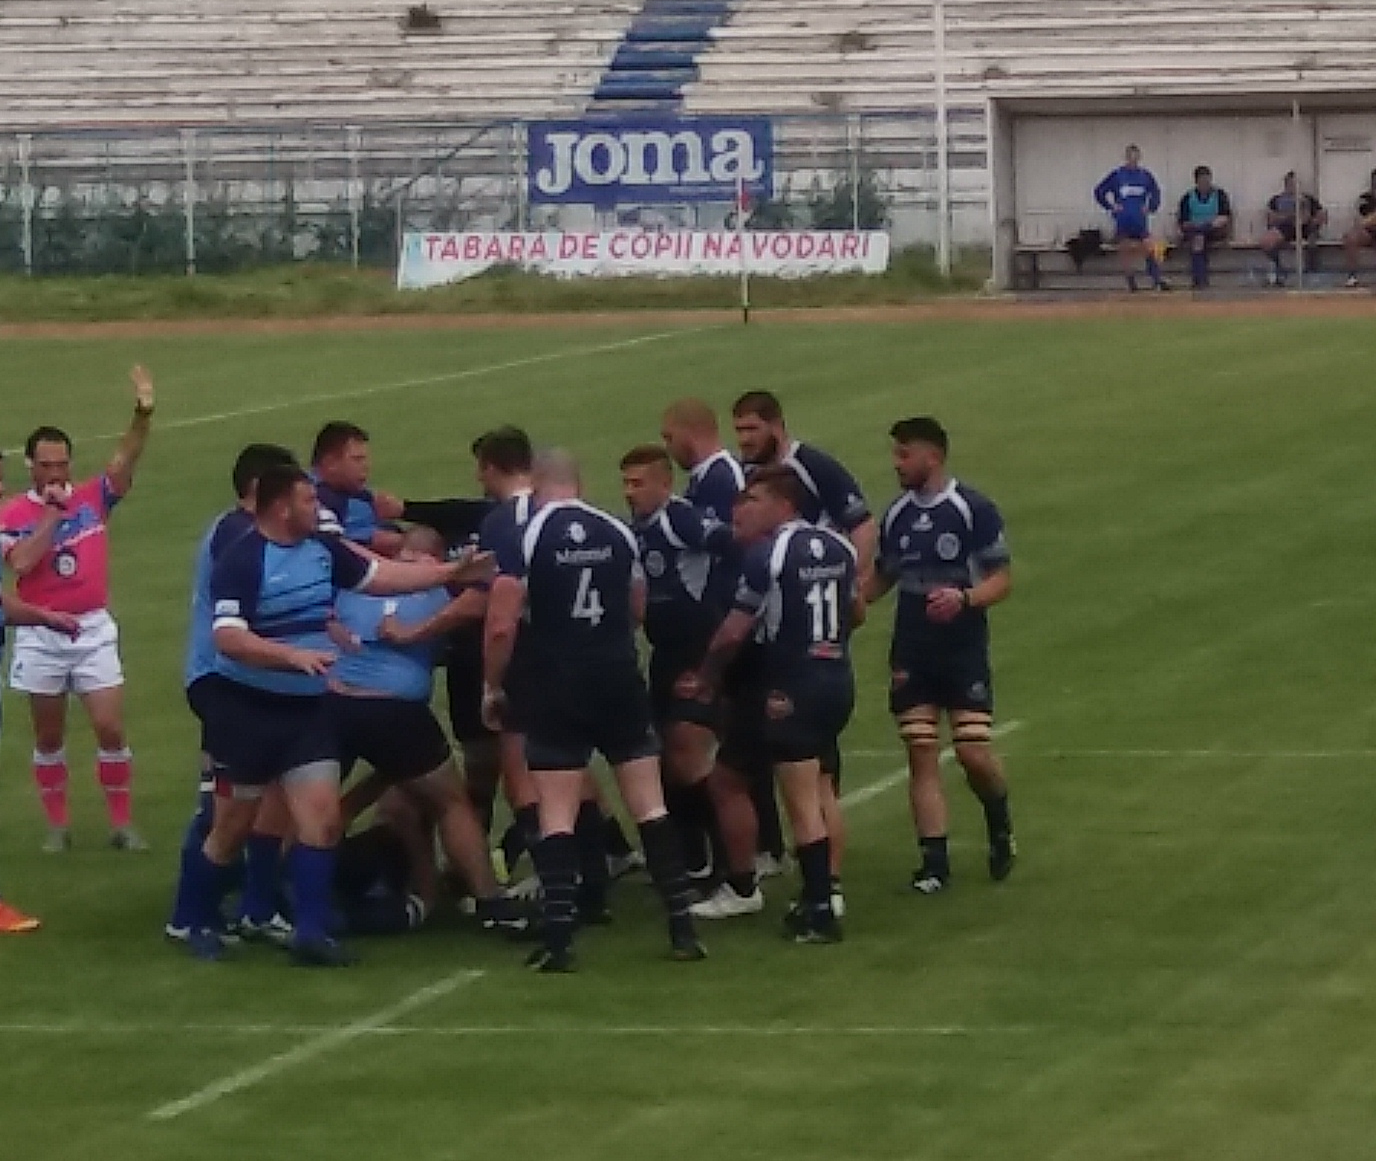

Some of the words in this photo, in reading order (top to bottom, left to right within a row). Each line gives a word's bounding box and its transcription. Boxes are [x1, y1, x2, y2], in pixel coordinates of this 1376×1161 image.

[559, 233, 600, 260] DE
[608, 231, 693, 260] COPII
[570, 567, 605, 627] 4
[805, 579, 838, 642] 11
